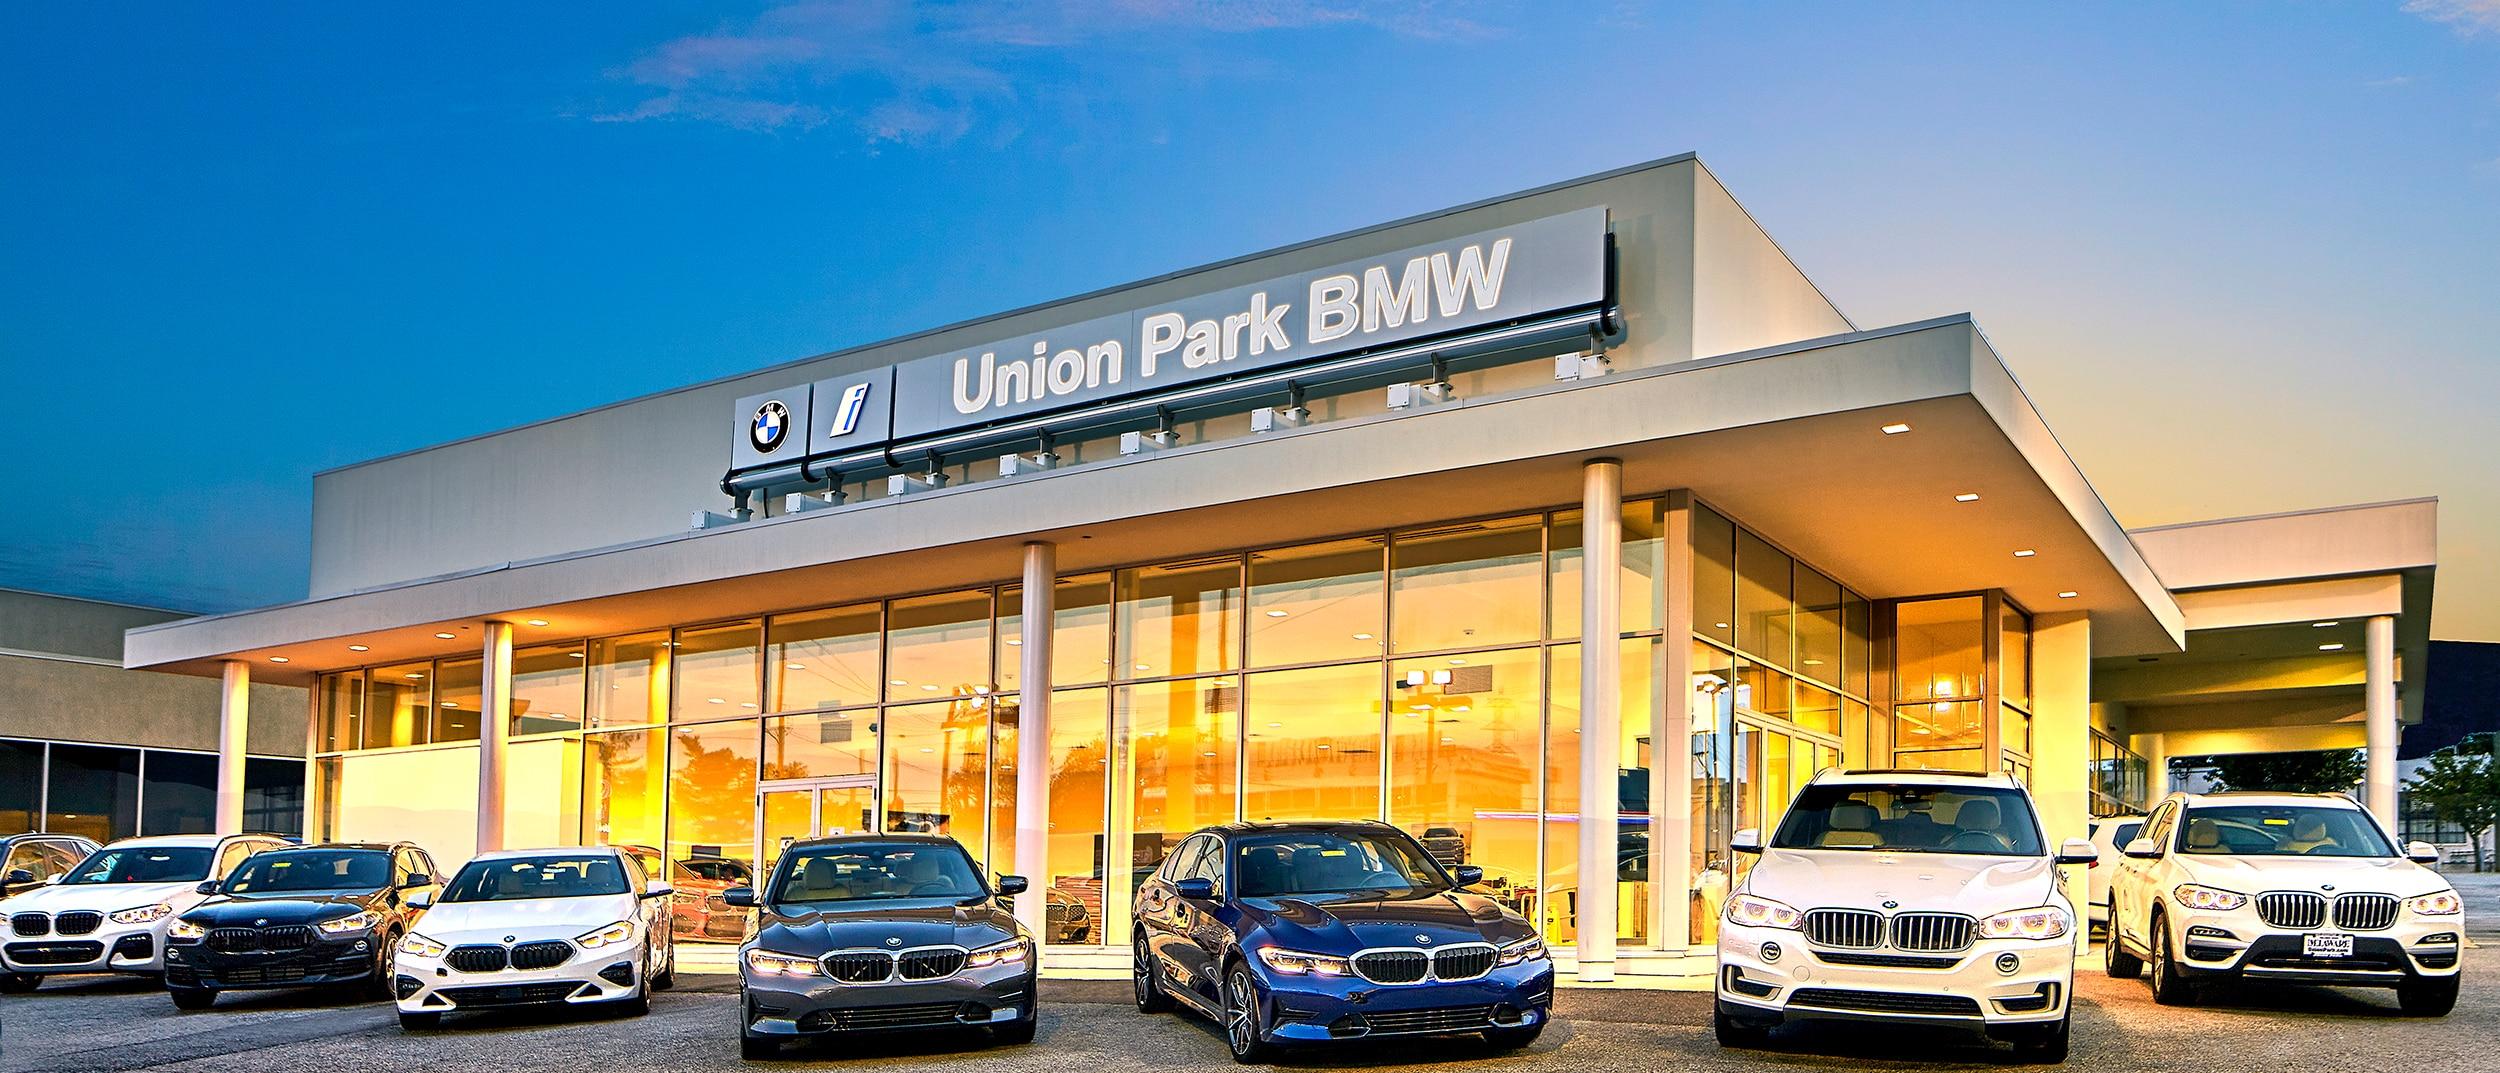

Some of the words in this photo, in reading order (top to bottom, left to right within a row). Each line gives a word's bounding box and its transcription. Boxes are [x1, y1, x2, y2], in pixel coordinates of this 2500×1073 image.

[953, 340, 1122, 414] Union
[1140, 292, 1292, 378] Park
[1308, 238, 1512, 344] BMW
[754, 403, 787, 422] BMW
[838, 385, 868, 434] i
